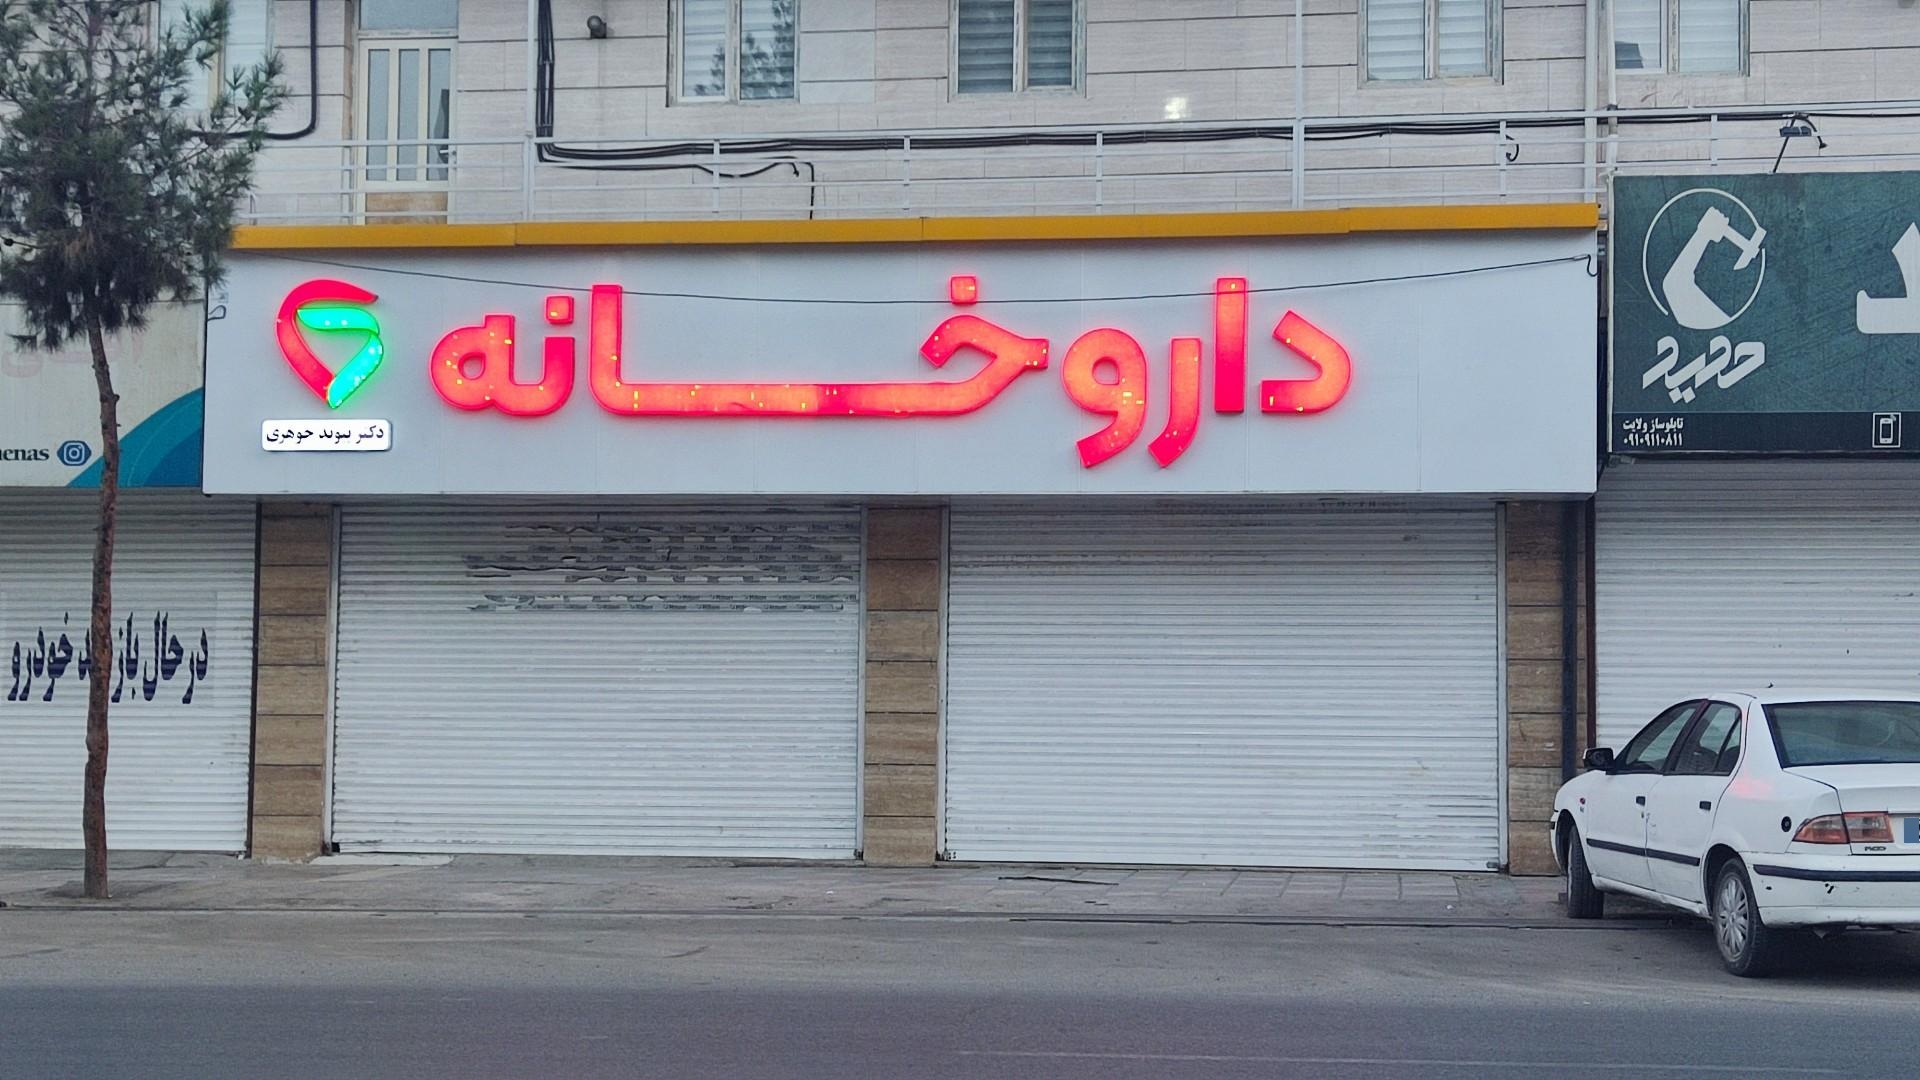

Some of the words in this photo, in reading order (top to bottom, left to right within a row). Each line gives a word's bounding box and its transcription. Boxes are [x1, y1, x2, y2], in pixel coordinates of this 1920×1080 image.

[430, 276, 1352, 468] داروخانه
[1642, 335, 1766, 404] حدید
[0, 448, 50, 461] enas
[1623, 417, 1649, 433] ولایت
[7, 611, 74, 702] خودرو
[142, 609, 184, 702] حال
[182, 627, 208, 704] در
